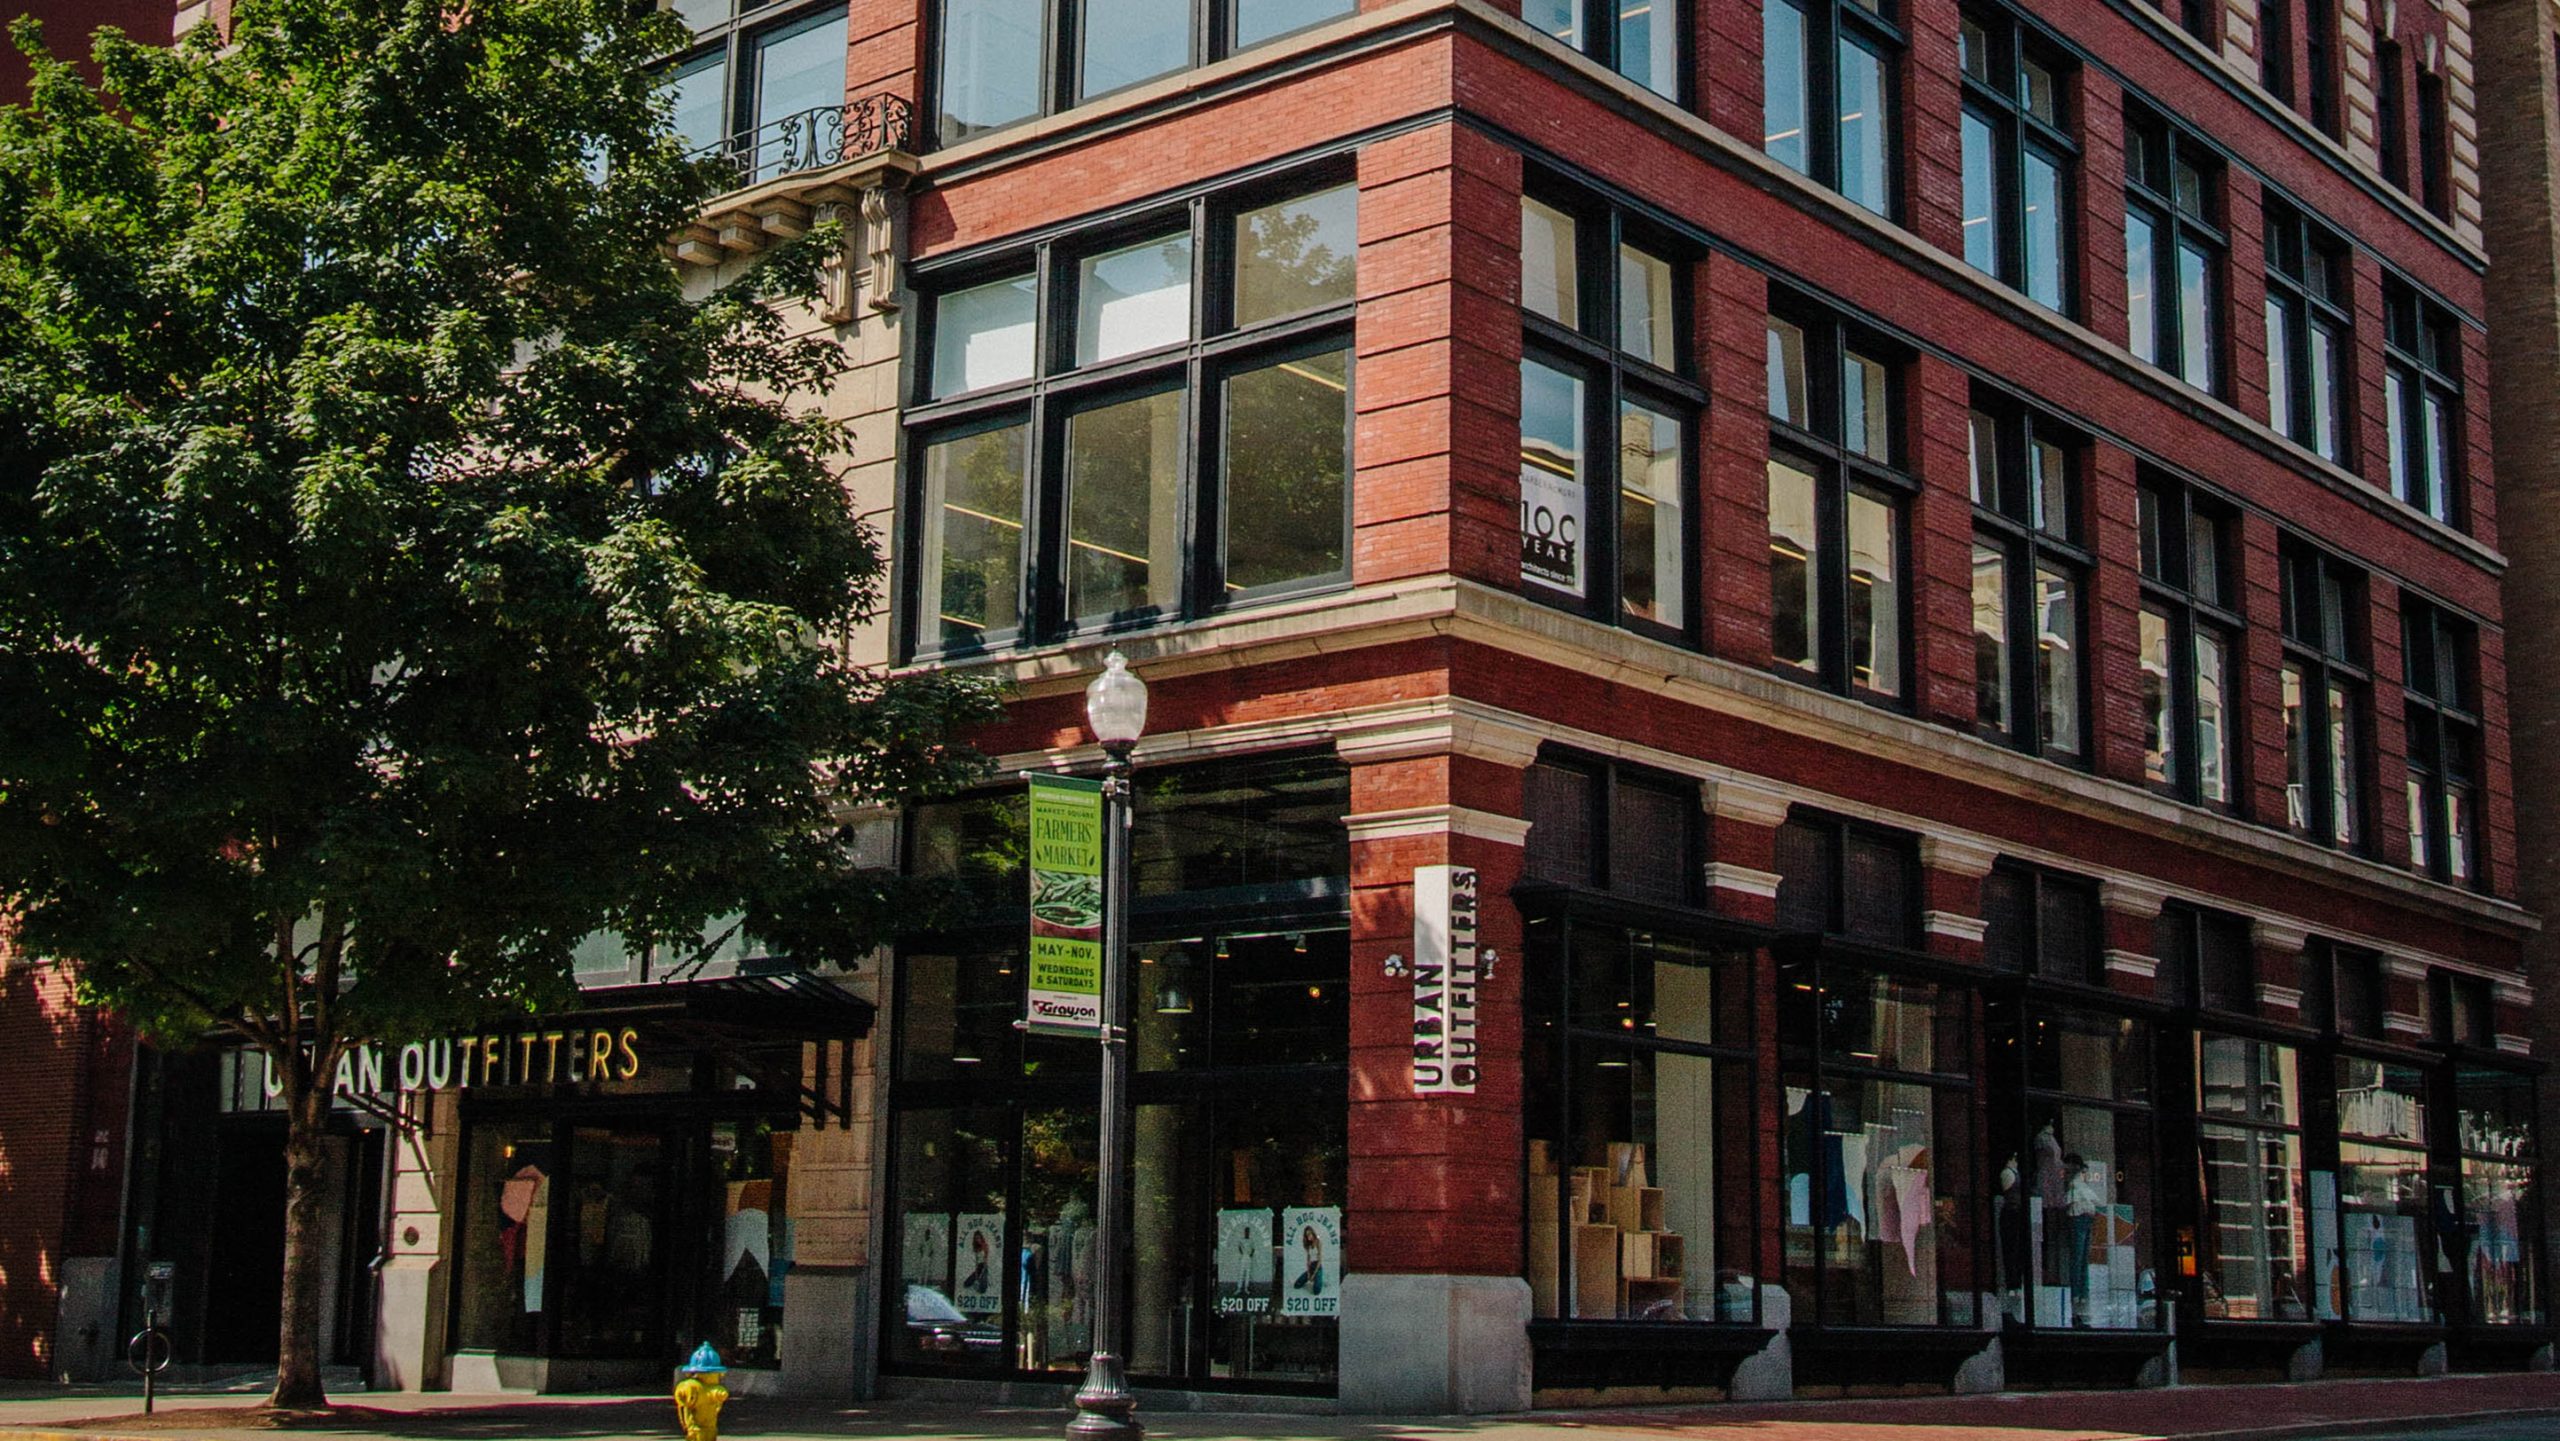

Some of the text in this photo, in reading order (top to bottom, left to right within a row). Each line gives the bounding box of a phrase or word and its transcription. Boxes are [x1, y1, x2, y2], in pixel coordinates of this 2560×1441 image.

[1043, 845, 1089, 867] MARKET
[1037, 963, 1095, 977] WEDNESDAYS
[1037, 976, 1095, 989] & SATURDAYS
[1451, 871, 1481, 1087] OUTFITTERS
[1043, 1002, 1097, 1017] Grayson
[1414, 964, 1444, 1087] URBAN
[400, 1027, 640, 1090] OUTFITTERS
[1286, 1226, 1298, 1246] ALL
[1317, 1214, 1339, 1245] JEANS
[957, 1295, 976, 1310] $20
[980, 1295, 999, 1310] OFF
[1220, 1297, 1270, 1313] $20 OFF
[1287, 1297, 1337, 1312] $20 OFF
